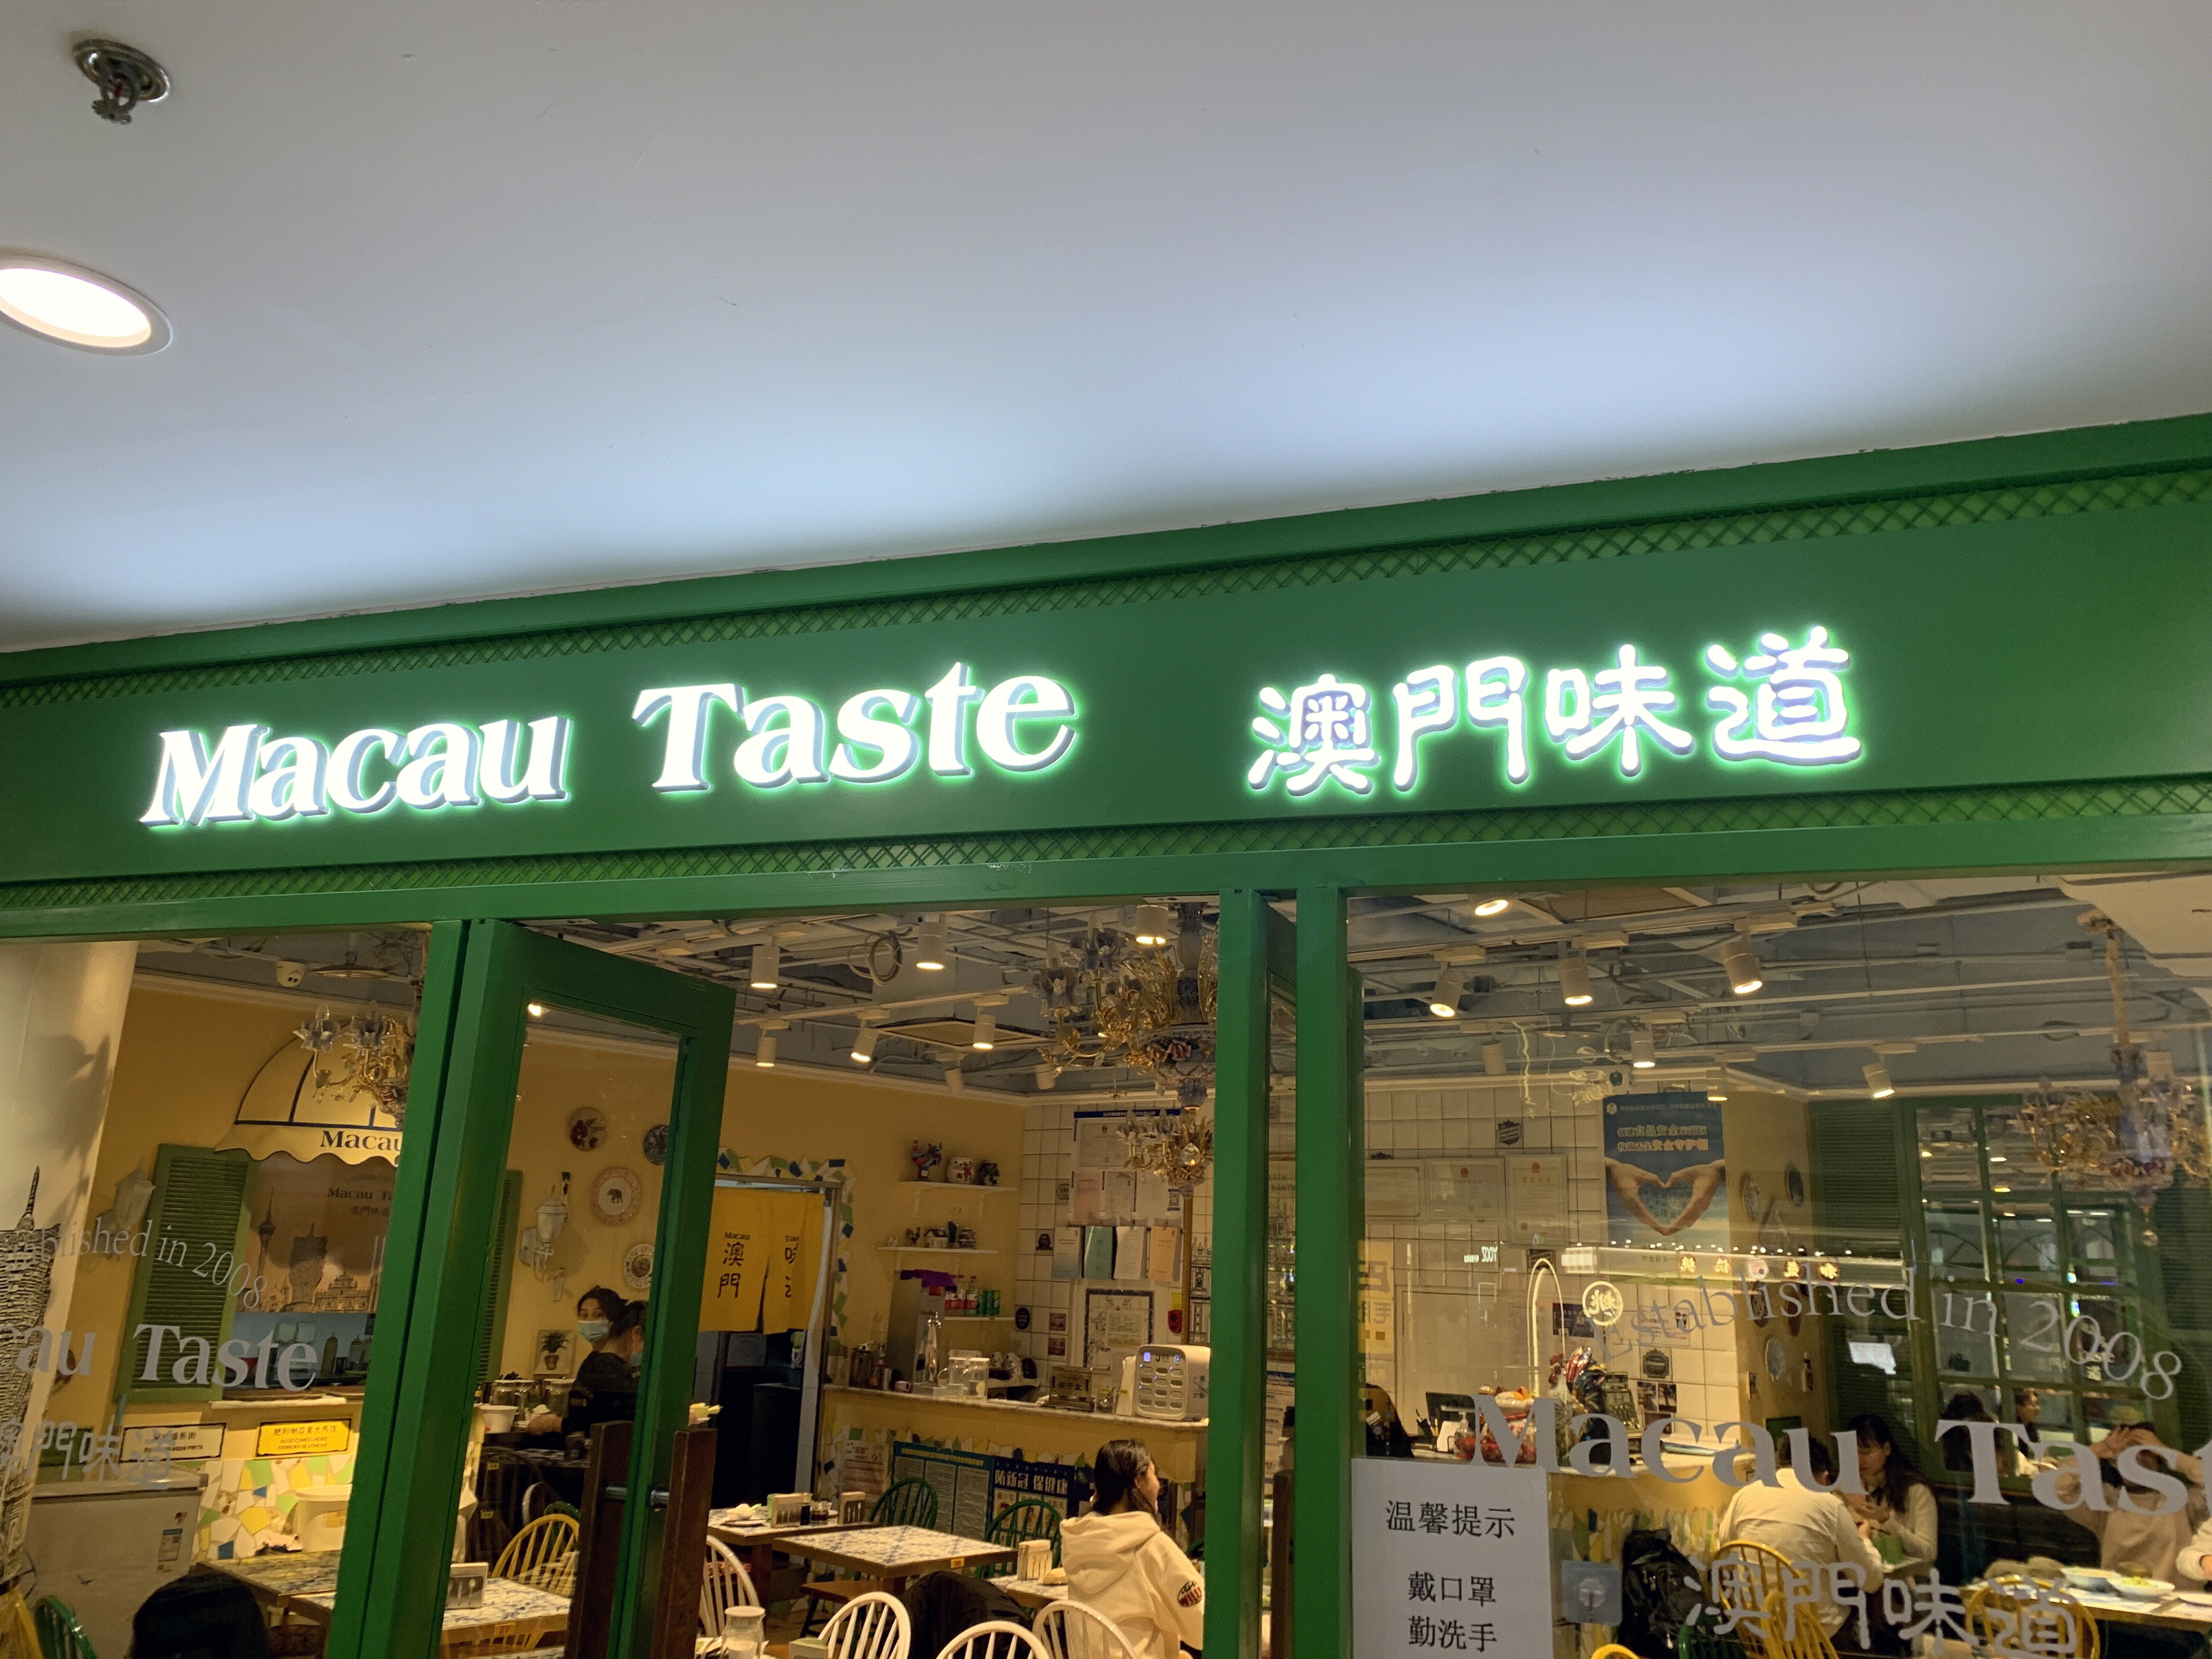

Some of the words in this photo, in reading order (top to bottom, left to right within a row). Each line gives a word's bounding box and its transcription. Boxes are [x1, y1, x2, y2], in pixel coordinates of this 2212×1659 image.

[139, 715, 573, 827] Macau
[631, 661, 1078, 792] Taste
[1247, 625, 1863, 798] 澳門味道
[154, 1224, 187, 1268] in
[192, 1242, 268, 1308] 2008
[717, 1242, 745, 1299] 澳門
[133, 1324, 318, 1392] Taste
[1588, 1262, 1920, 1363] Established
[1942, 1274, 1999, 1338] in
[2019, 1301, 2182, 1400] 2008
[1468, 1395, 1870, 1496] Macau
[1386, 1499, 1516, 1539] 温馨提示
[1407, 1571, 1497, 1607] 戴口罩
[1684, 1553, 2083, 1659] 澳門味道
[1407, 1616, 1498, 1652] 勤洗手
